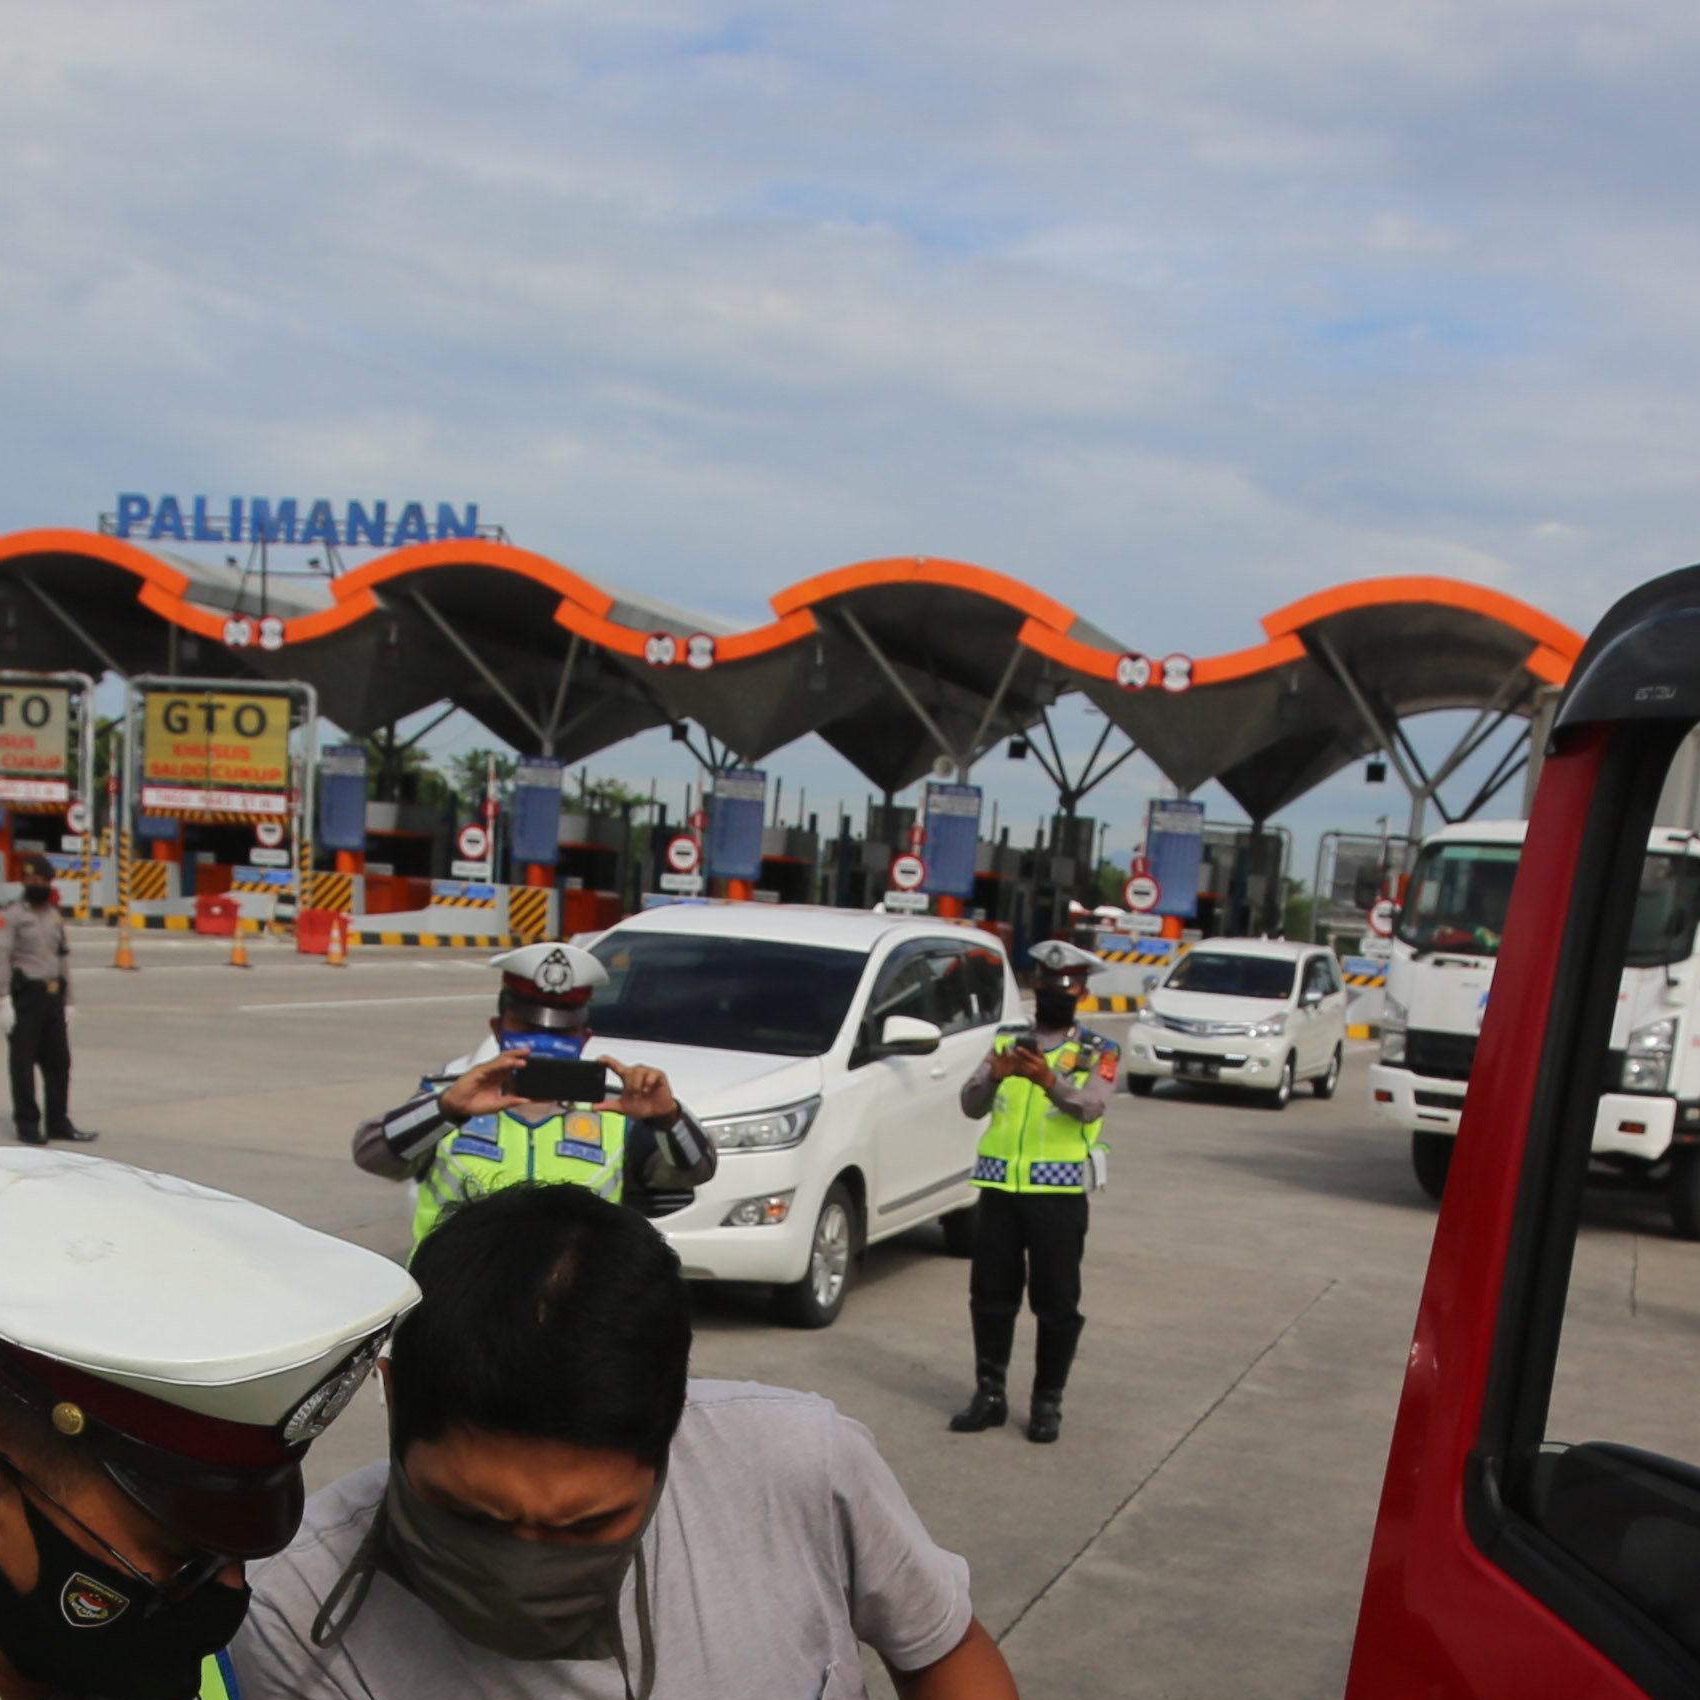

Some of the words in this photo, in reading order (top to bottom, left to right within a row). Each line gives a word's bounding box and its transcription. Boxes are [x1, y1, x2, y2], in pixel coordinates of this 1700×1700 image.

[116, 491, 479, 547] PALIMANAN
[163, 700, 268, 737] GTO
[2, 752, 63, 771] CUKUP
[172, 743, 251, 761] KHUSUS
[150, 761, 206, 780] SALDO
[211, 763, 282, 782] CUKUP
